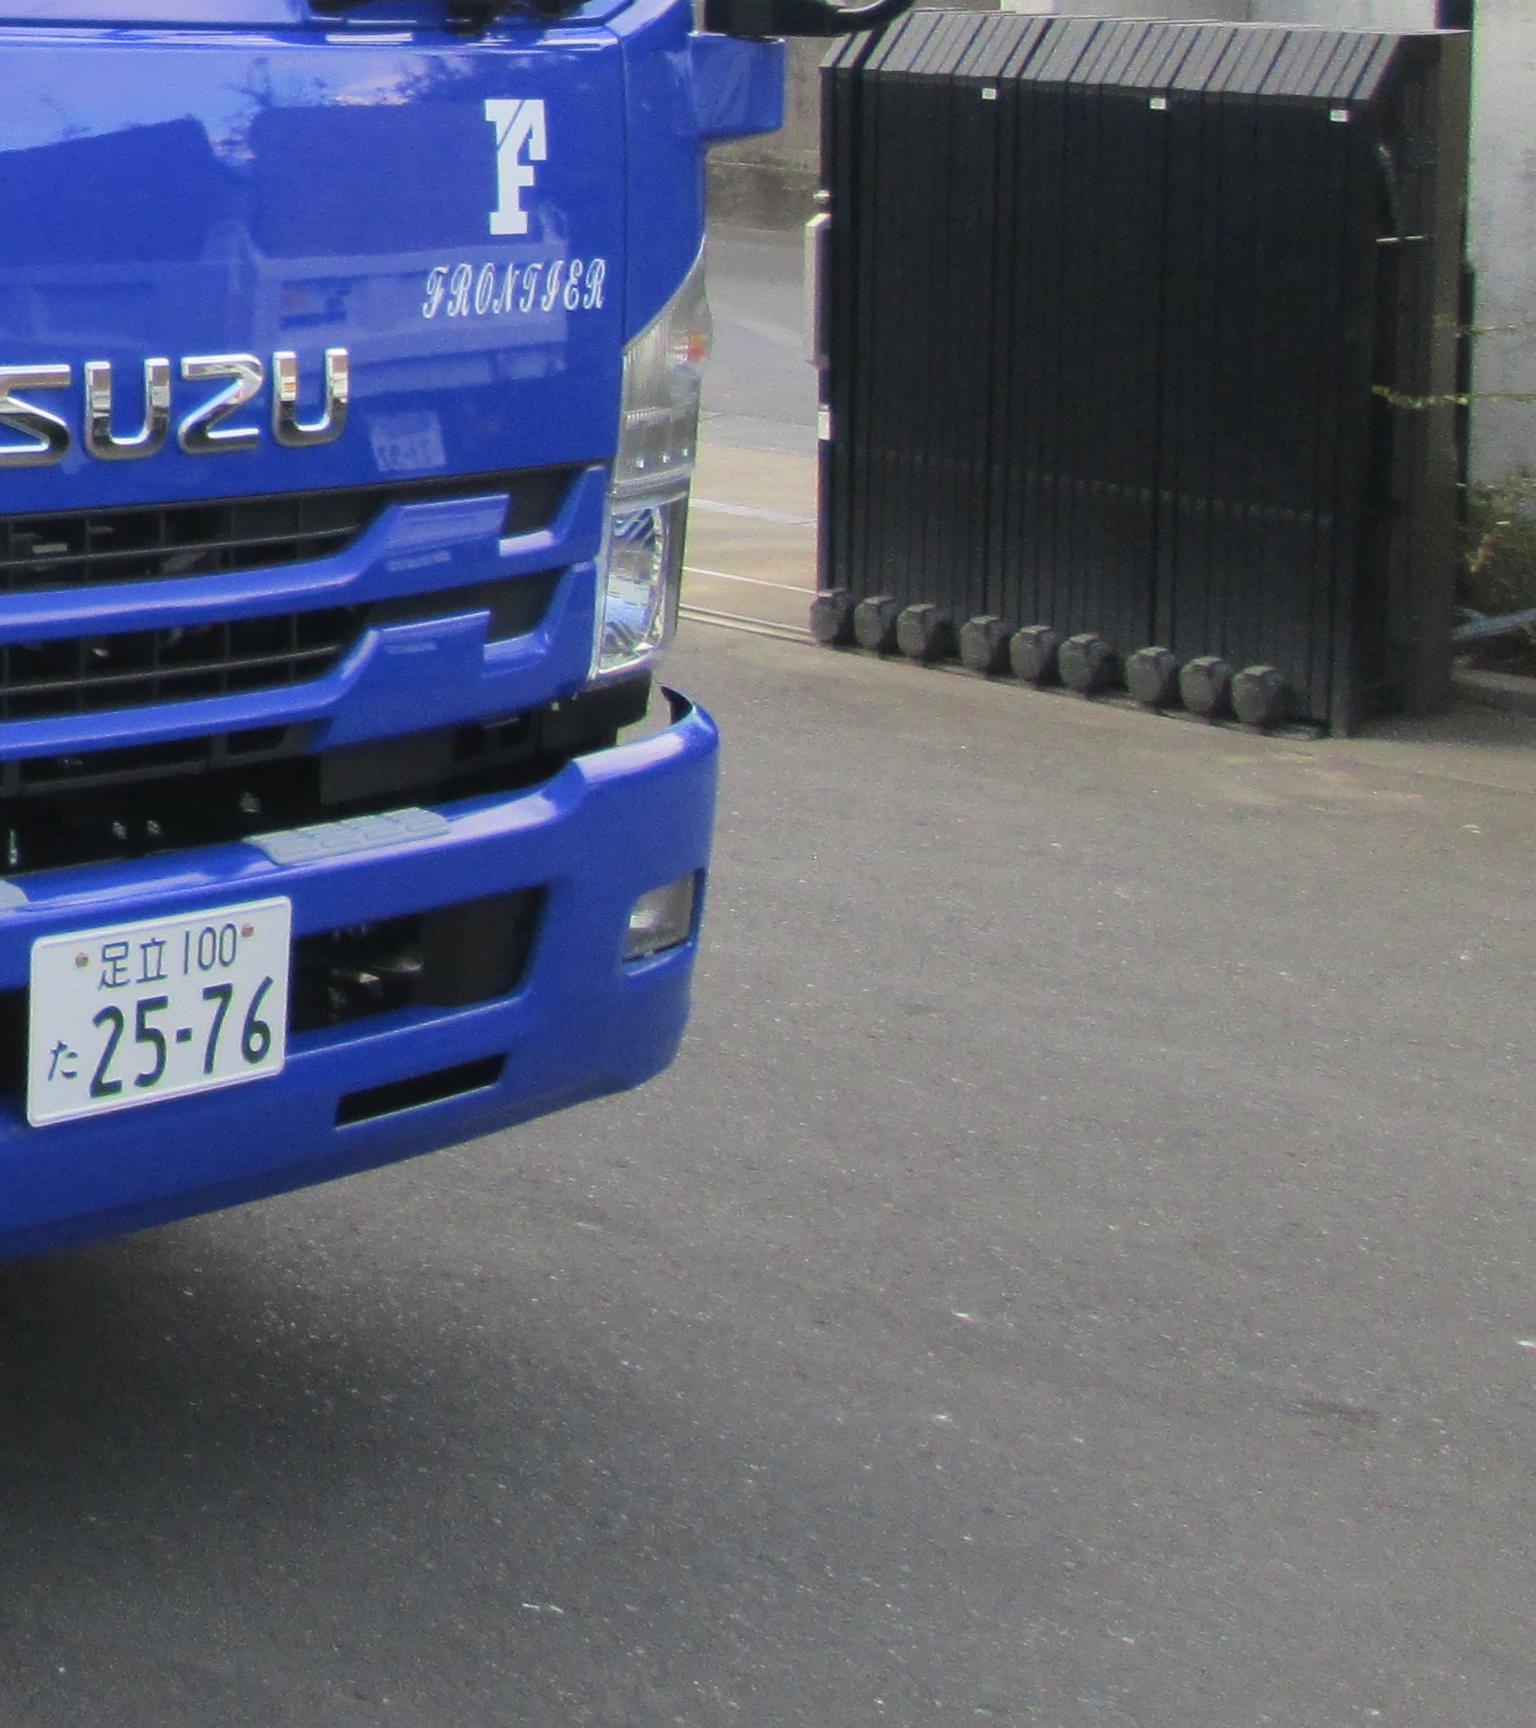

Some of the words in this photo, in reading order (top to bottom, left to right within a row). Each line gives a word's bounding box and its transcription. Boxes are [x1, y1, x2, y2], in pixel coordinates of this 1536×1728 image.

[422, 258, 606, 319] FRONTIER
[98, 937, 168, 991] 足立
[182, 923, 238, 975] 100
[46, 1040, 78, 1081] た
[90, 975, 275, 1098] 25-76
